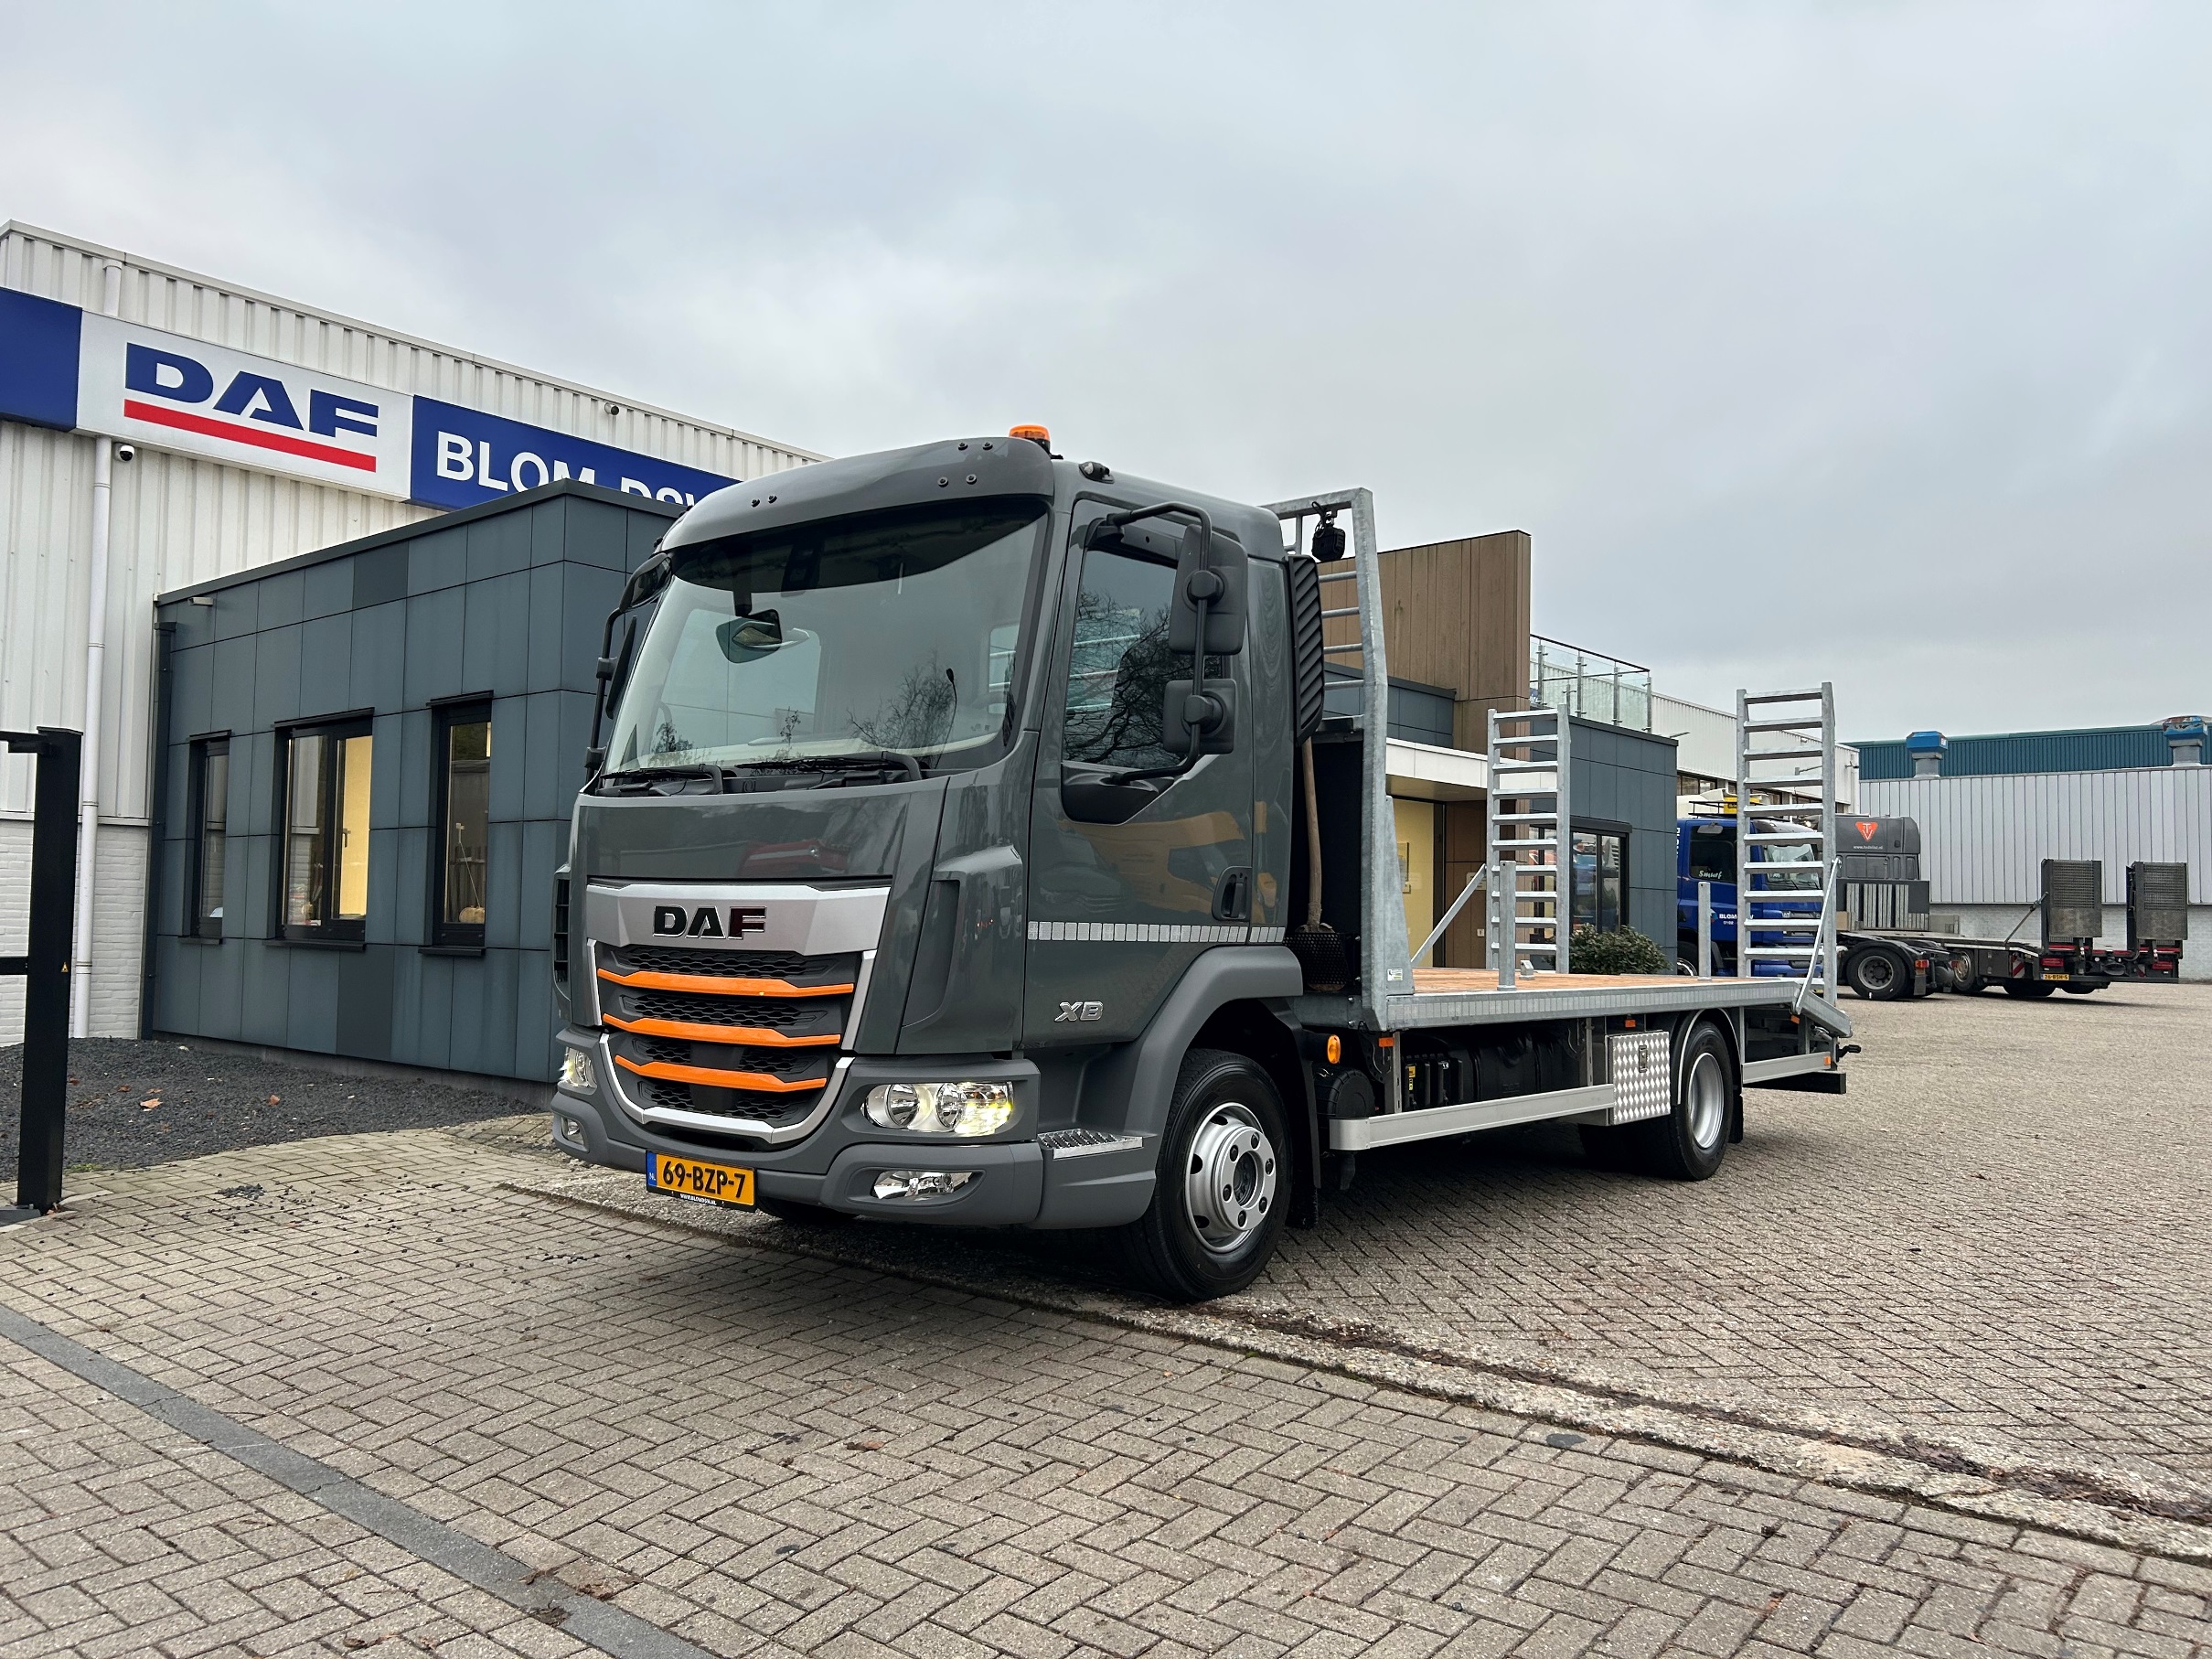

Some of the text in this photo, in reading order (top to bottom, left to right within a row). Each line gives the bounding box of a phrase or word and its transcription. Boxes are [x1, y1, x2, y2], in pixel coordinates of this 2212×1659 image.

[126, 342, 379, 438] DAF
[652, 904, 767, 940] DAF
[1053, 1001, 1105, 1022] XB
[663, 1161, 745, 1199] 69-BZP-7
